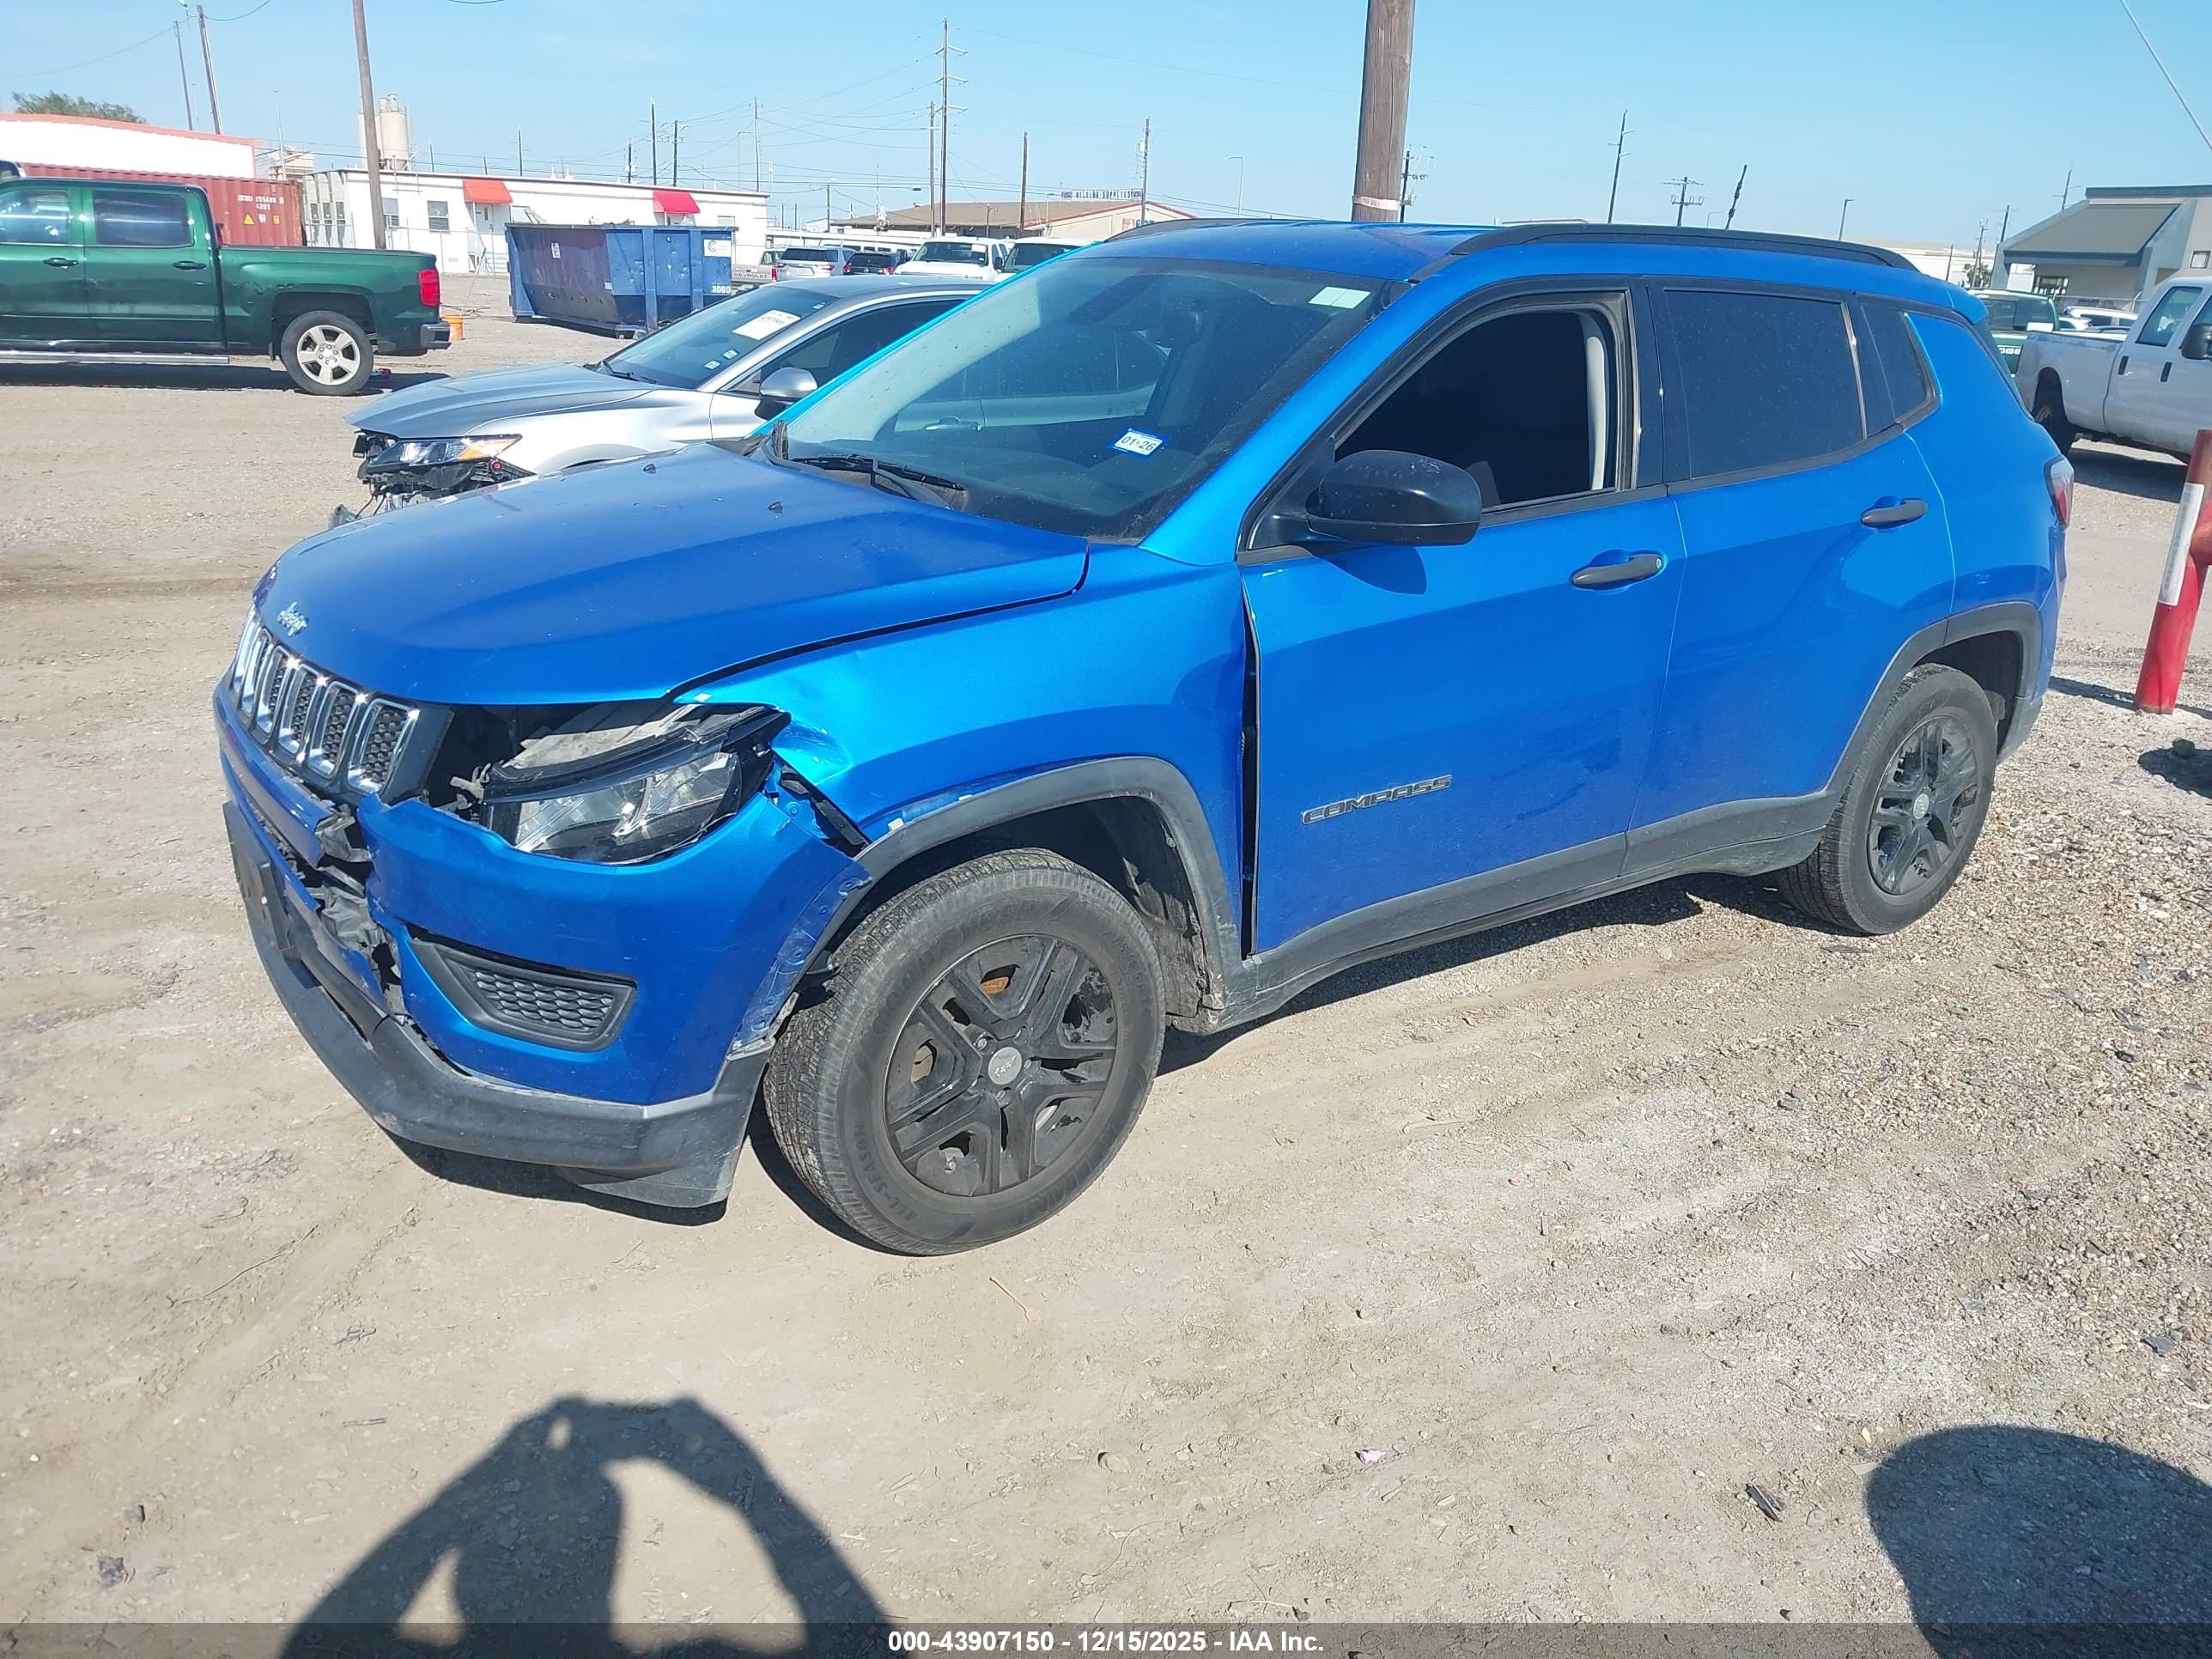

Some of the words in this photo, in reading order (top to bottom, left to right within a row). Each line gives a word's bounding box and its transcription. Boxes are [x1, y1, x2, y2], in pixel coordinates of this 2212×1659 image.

[276, 601, 307, 636] Jeep
[1302, 774, 1452, 825] COMPASS
[853, 1123, 919, 1221] ALL-SEASON
